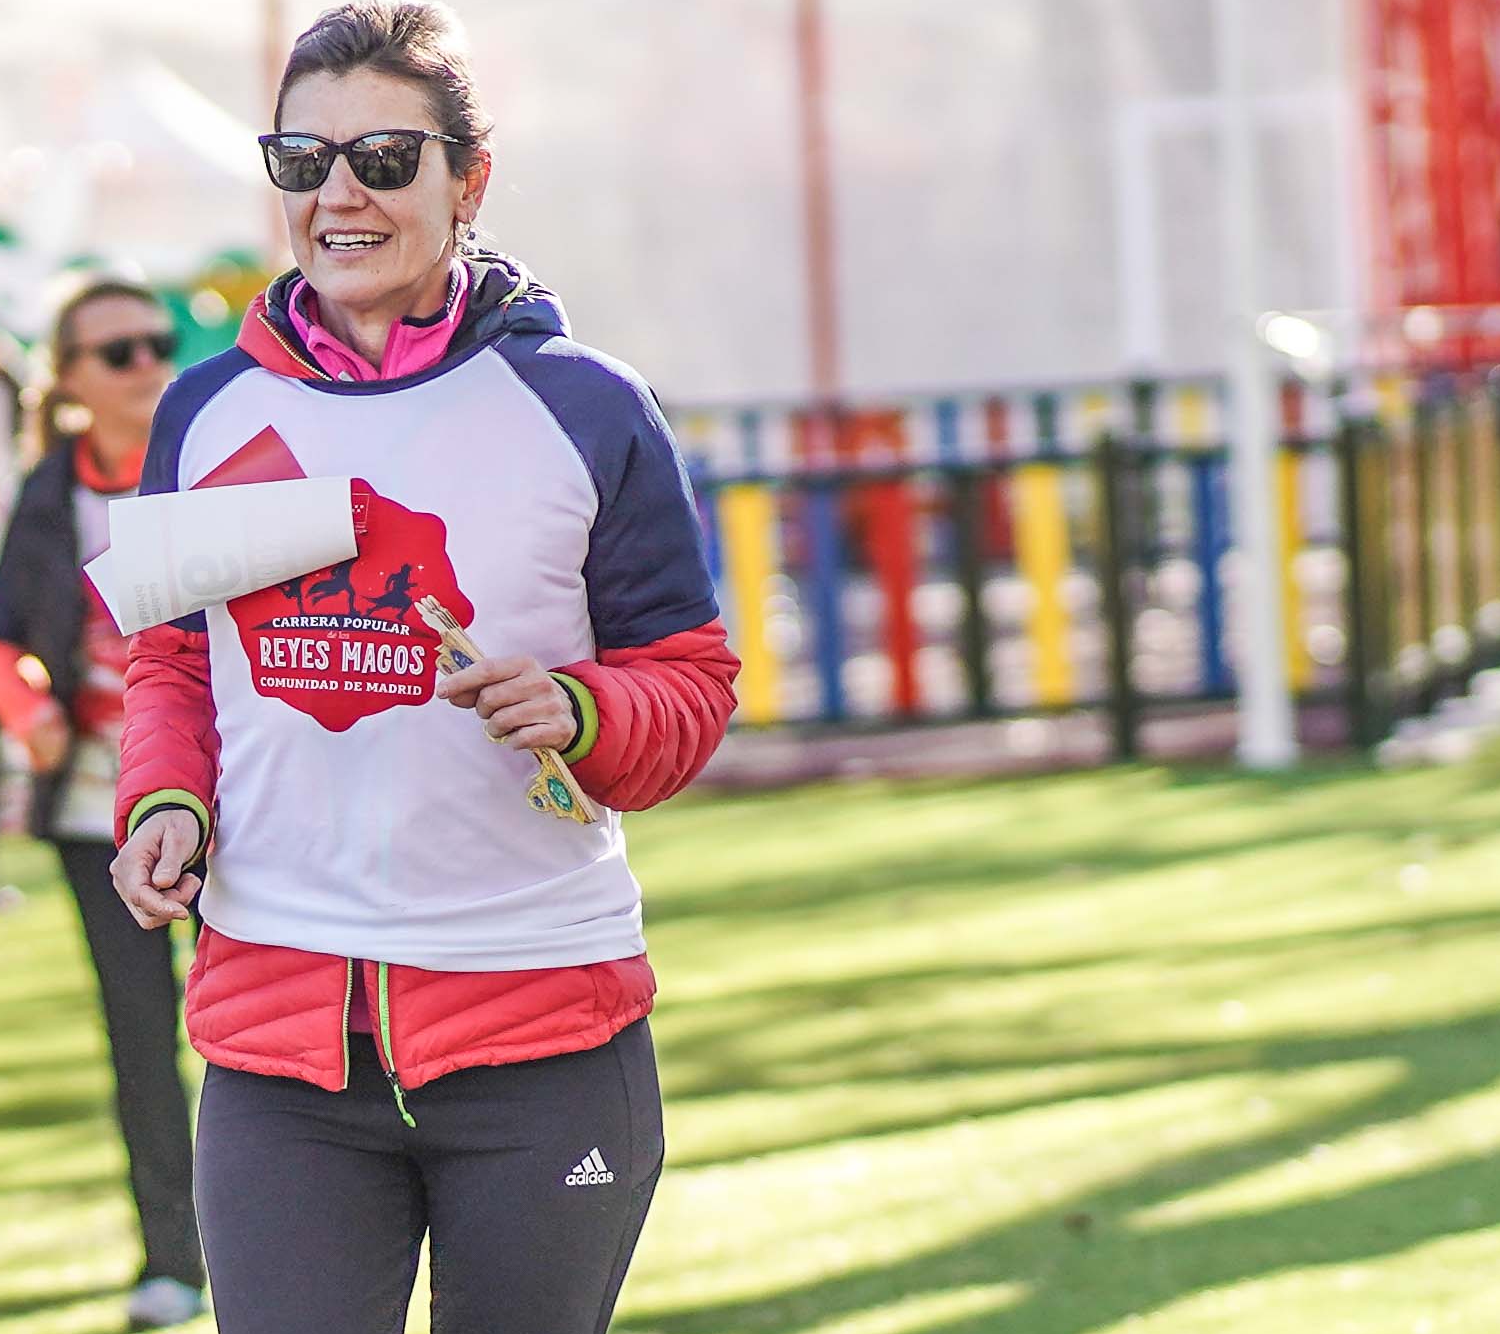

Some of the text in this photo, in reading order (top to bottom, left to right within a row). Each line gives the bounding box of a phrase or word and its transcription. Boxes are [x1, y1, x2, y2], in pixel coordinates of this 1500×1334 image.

[272, 616, 410, 636] CARRERA POPULAR
[259, 636, 425, 675] REYES MAGOS
[260, 676, 423, 696] COMUNIDAD DE MADRID
[564, 1171, 615, 1186] adidas
